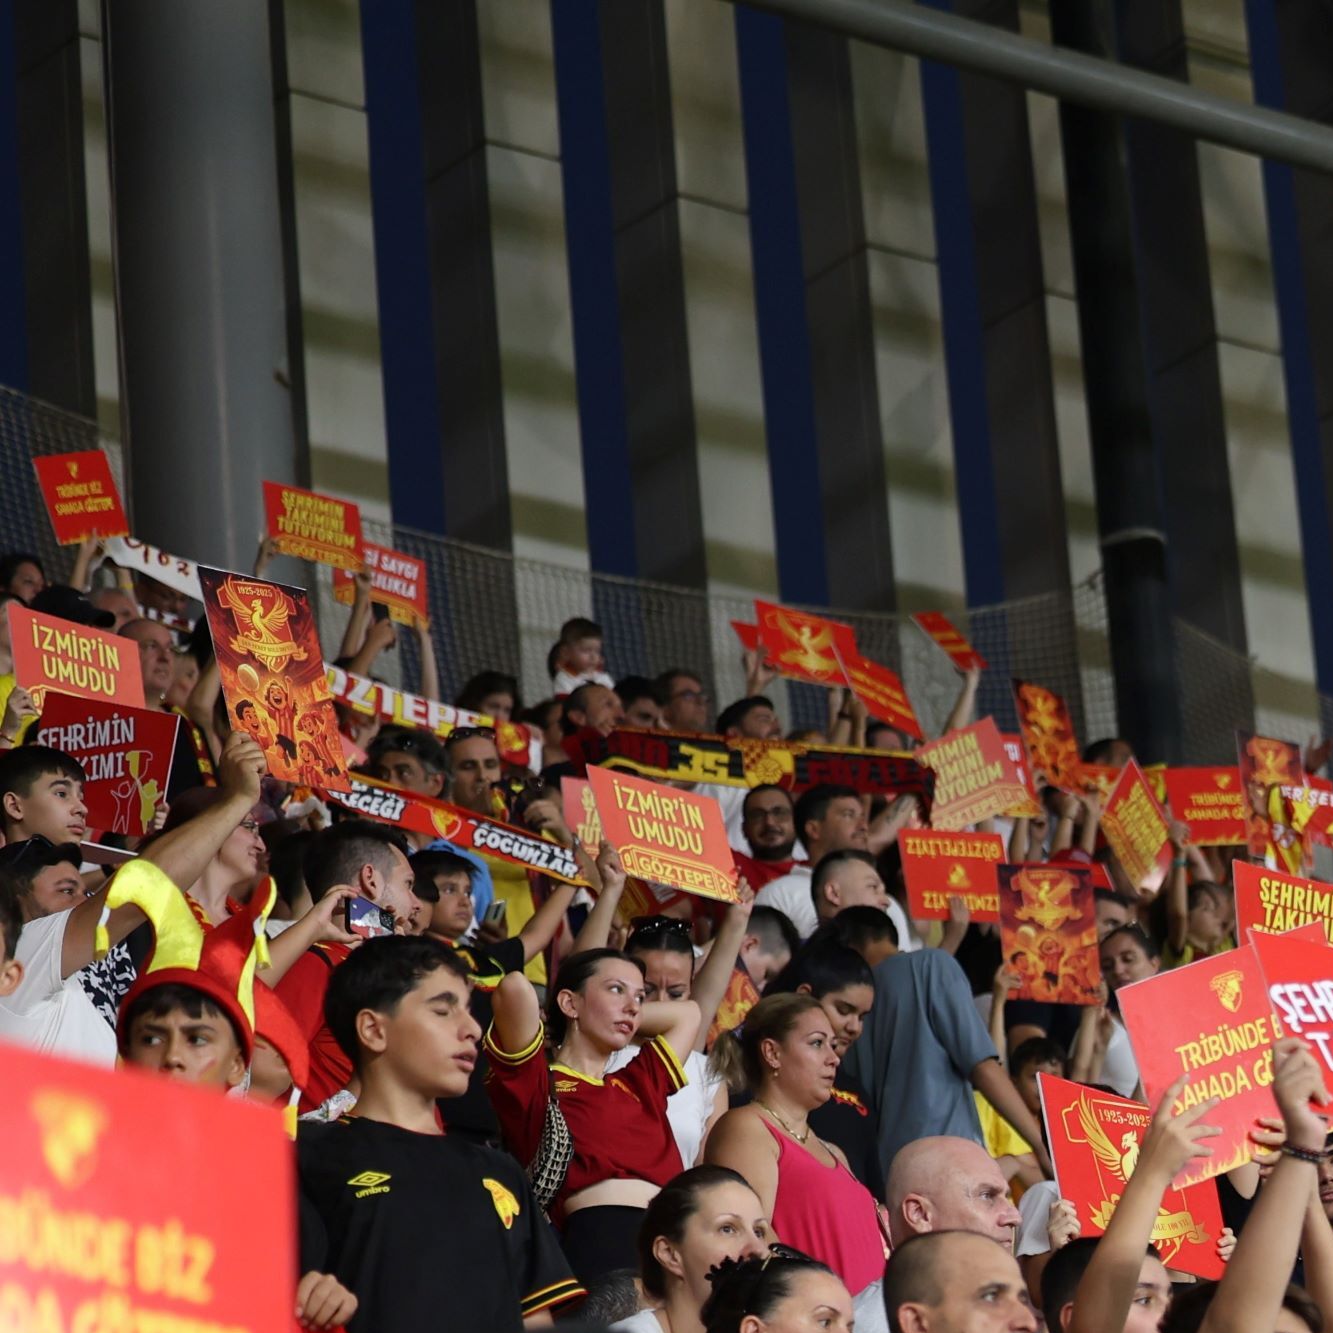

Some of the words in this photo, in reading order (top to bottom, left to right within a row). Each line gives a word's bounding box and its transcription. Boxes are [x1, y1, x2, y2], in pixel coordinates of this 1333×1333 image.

[32, 618, 120, 671] İZMİR'İN
[43, 654, 115, 696] UMUDU
[613, 779, 704, 830] İZMİR'İN
[473, 827, 578, 878] ÇOCUKLAR
[628, 815, 703, 855] UMUDU
[639, 857, 712, 888] GÖZTEPE
[1174, 1018, 1270, 1072] TRİBÜNDE
[355, 1184, 391, 1199] umbro
[135, 1217, 216, 1303] BİZ
